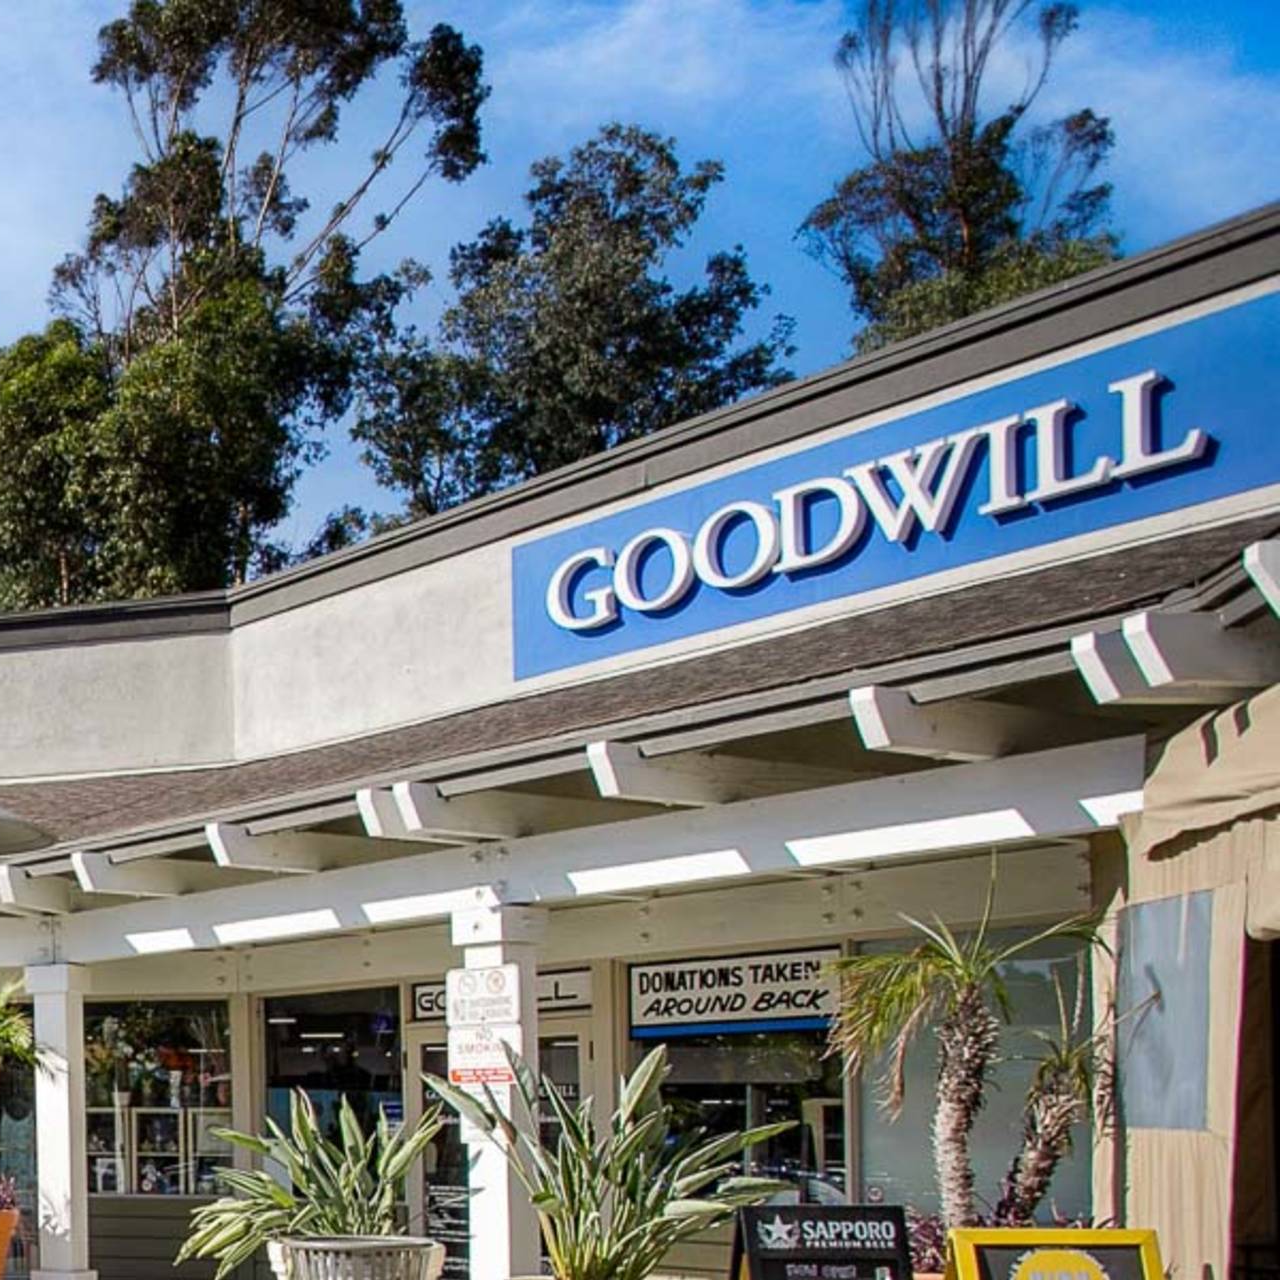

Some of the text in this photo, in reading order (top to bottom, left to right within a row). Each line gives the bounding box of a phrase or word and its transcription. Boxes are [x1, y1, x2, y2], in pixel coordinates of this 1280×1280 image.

[545, 369, 1211, 632] GOODWILL
[638, 960, 821, 995] DONATIONS TAKEN
[642, 988, 830, 1018] AROUND BACK
[801, 1220, 897, 1240] SAPPORO
[805, 1240, 896, 1249] PREMIUM BEER
